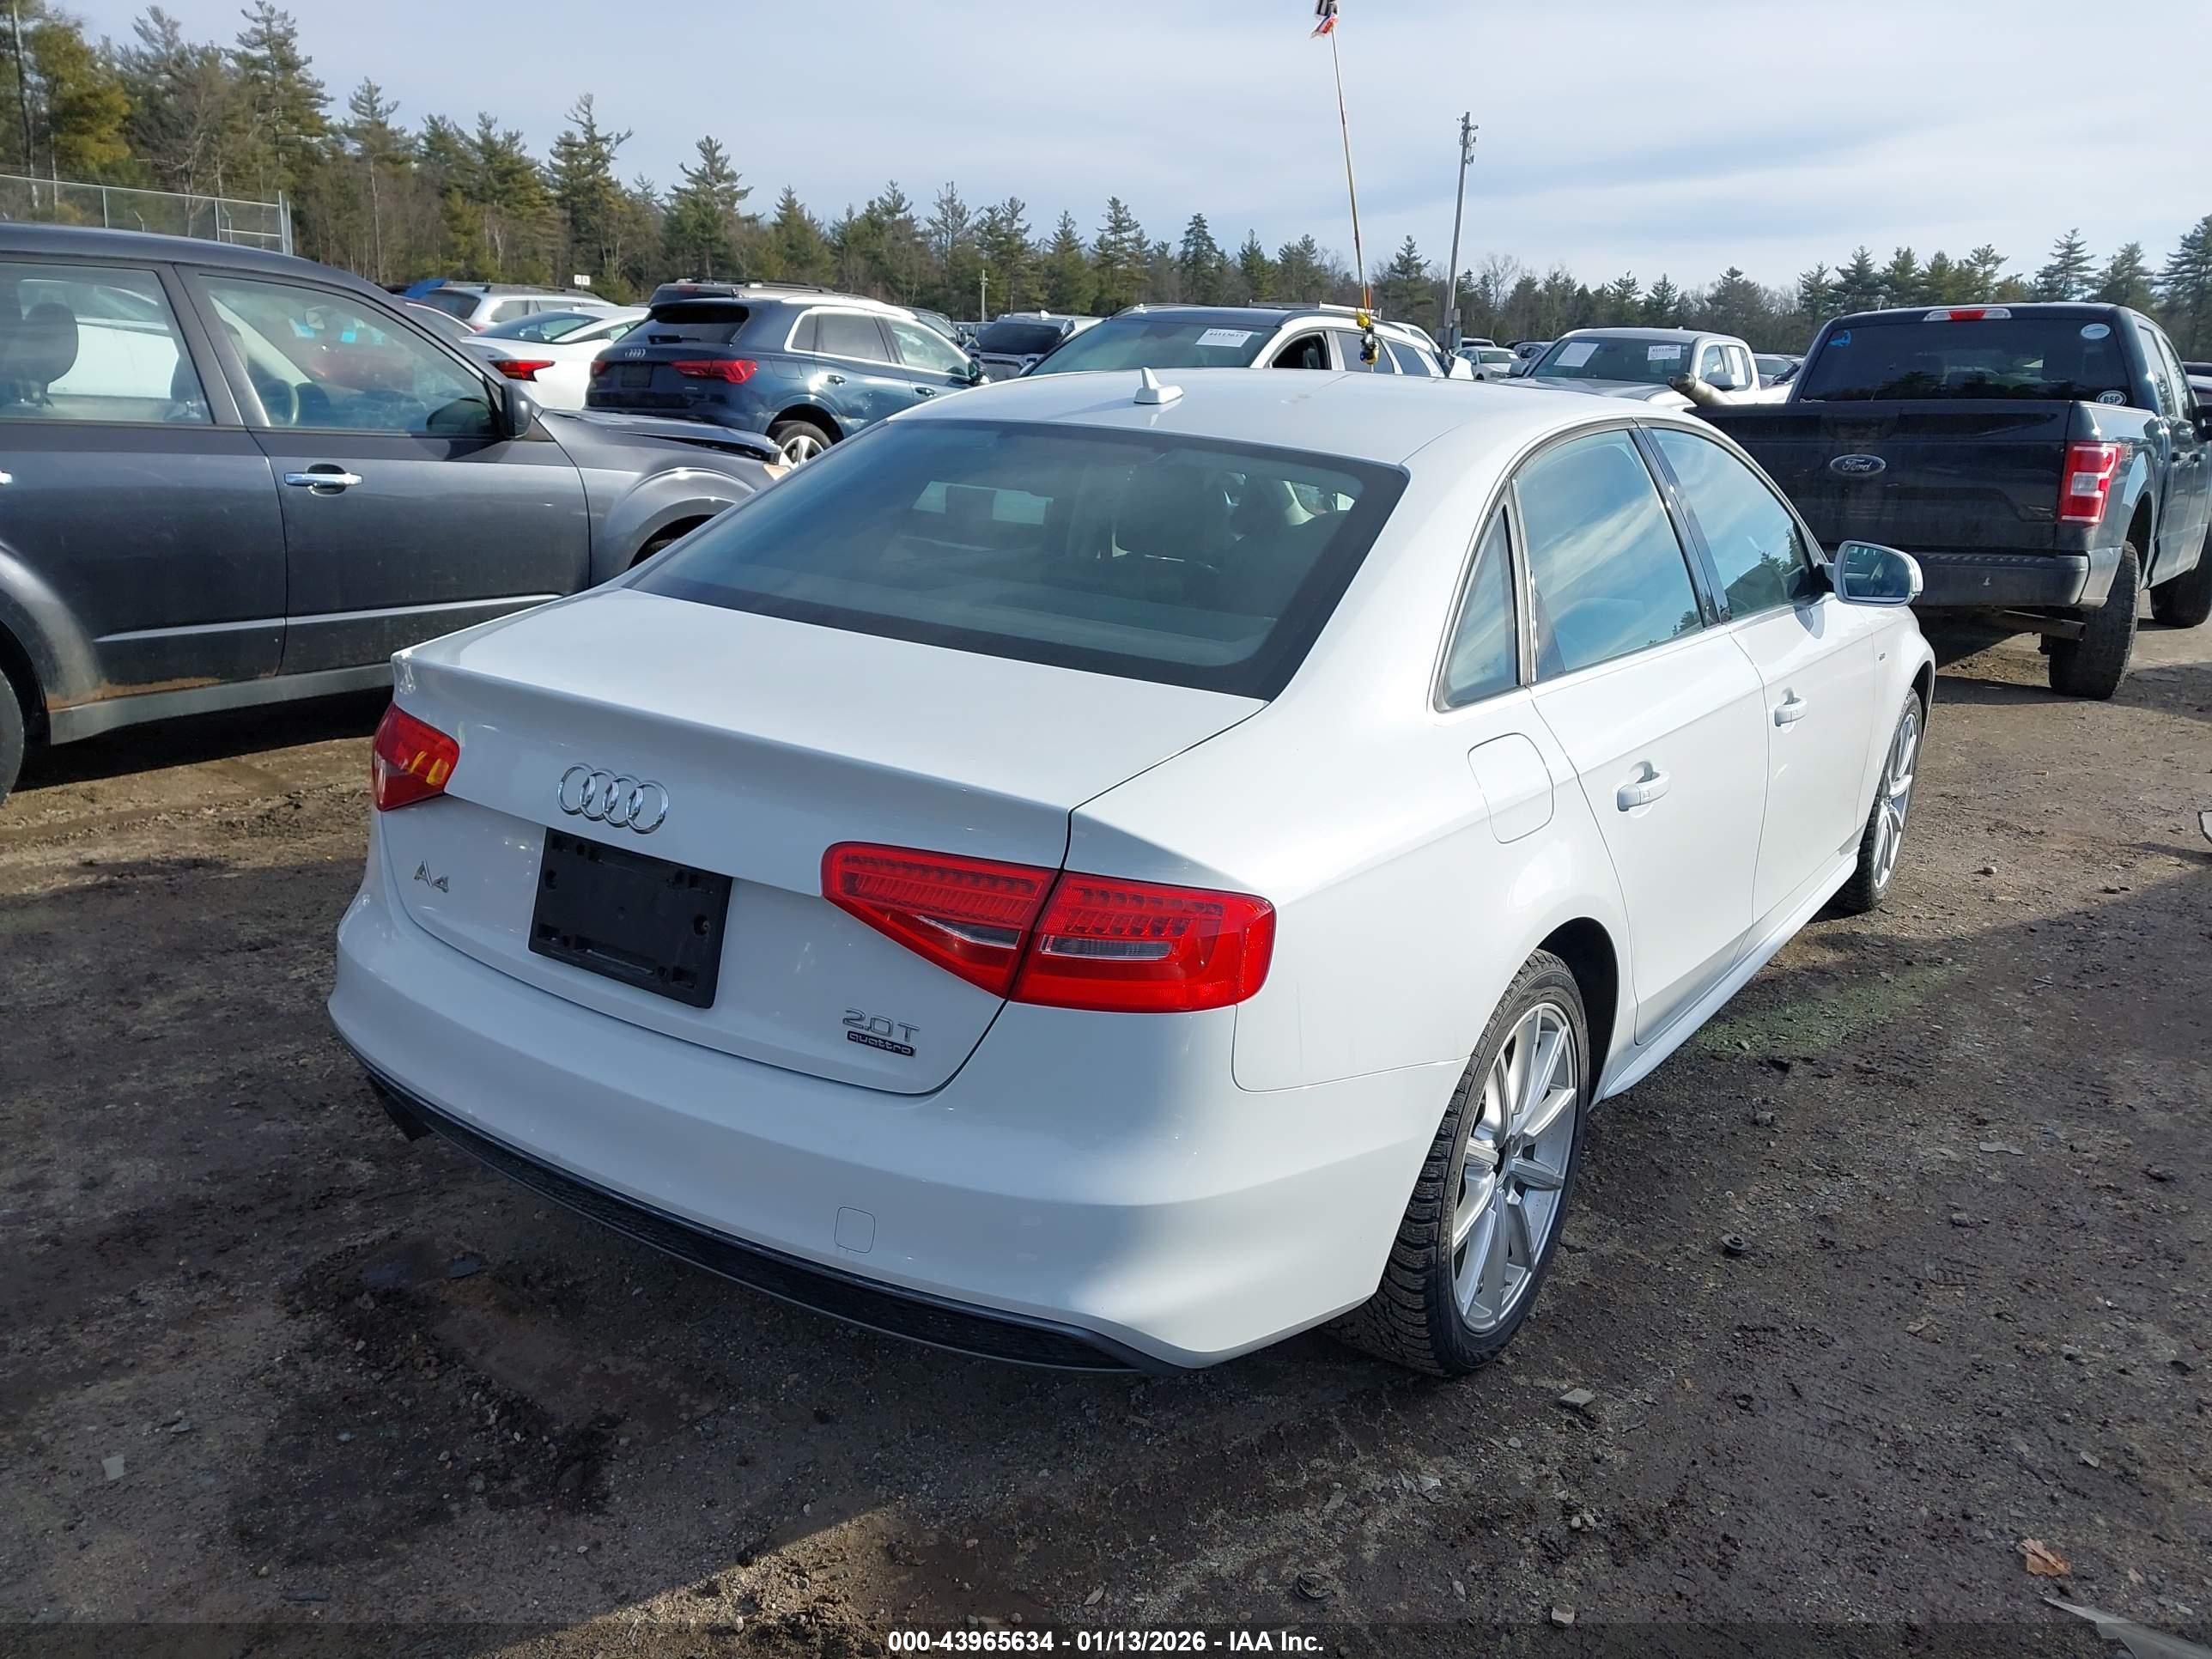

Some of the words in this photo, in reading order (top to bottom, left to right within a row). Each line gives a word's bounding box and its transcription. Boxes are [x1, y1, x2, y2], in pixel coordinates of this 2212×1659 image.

[1842, 459, 1873, 471] Ford
[413, 859, 449, 893] A4
[848, 1032, 912, 1054] quattro
